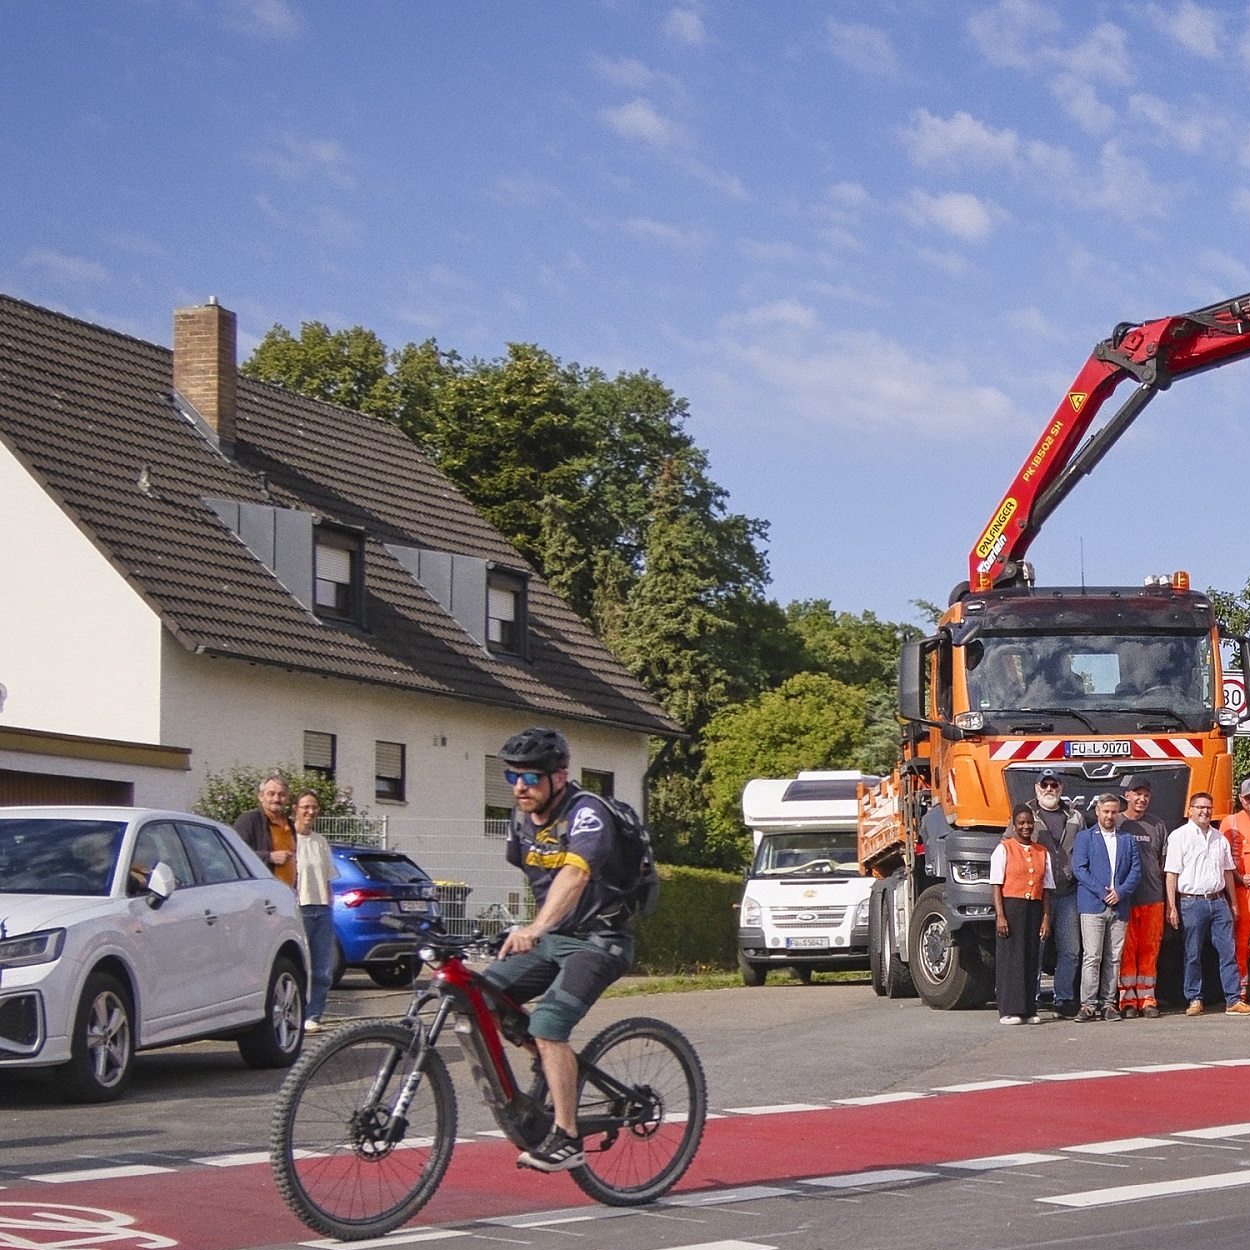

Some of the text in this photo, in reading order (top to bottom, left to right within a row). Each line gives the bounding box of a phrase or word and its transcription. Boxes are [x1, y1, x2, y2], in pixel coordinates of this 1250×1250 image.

[1023, 467, 1036, 482] PK
[979, 501, 1015, 555] PALFINGER
[1102, 742, 1129, 754] 9070
